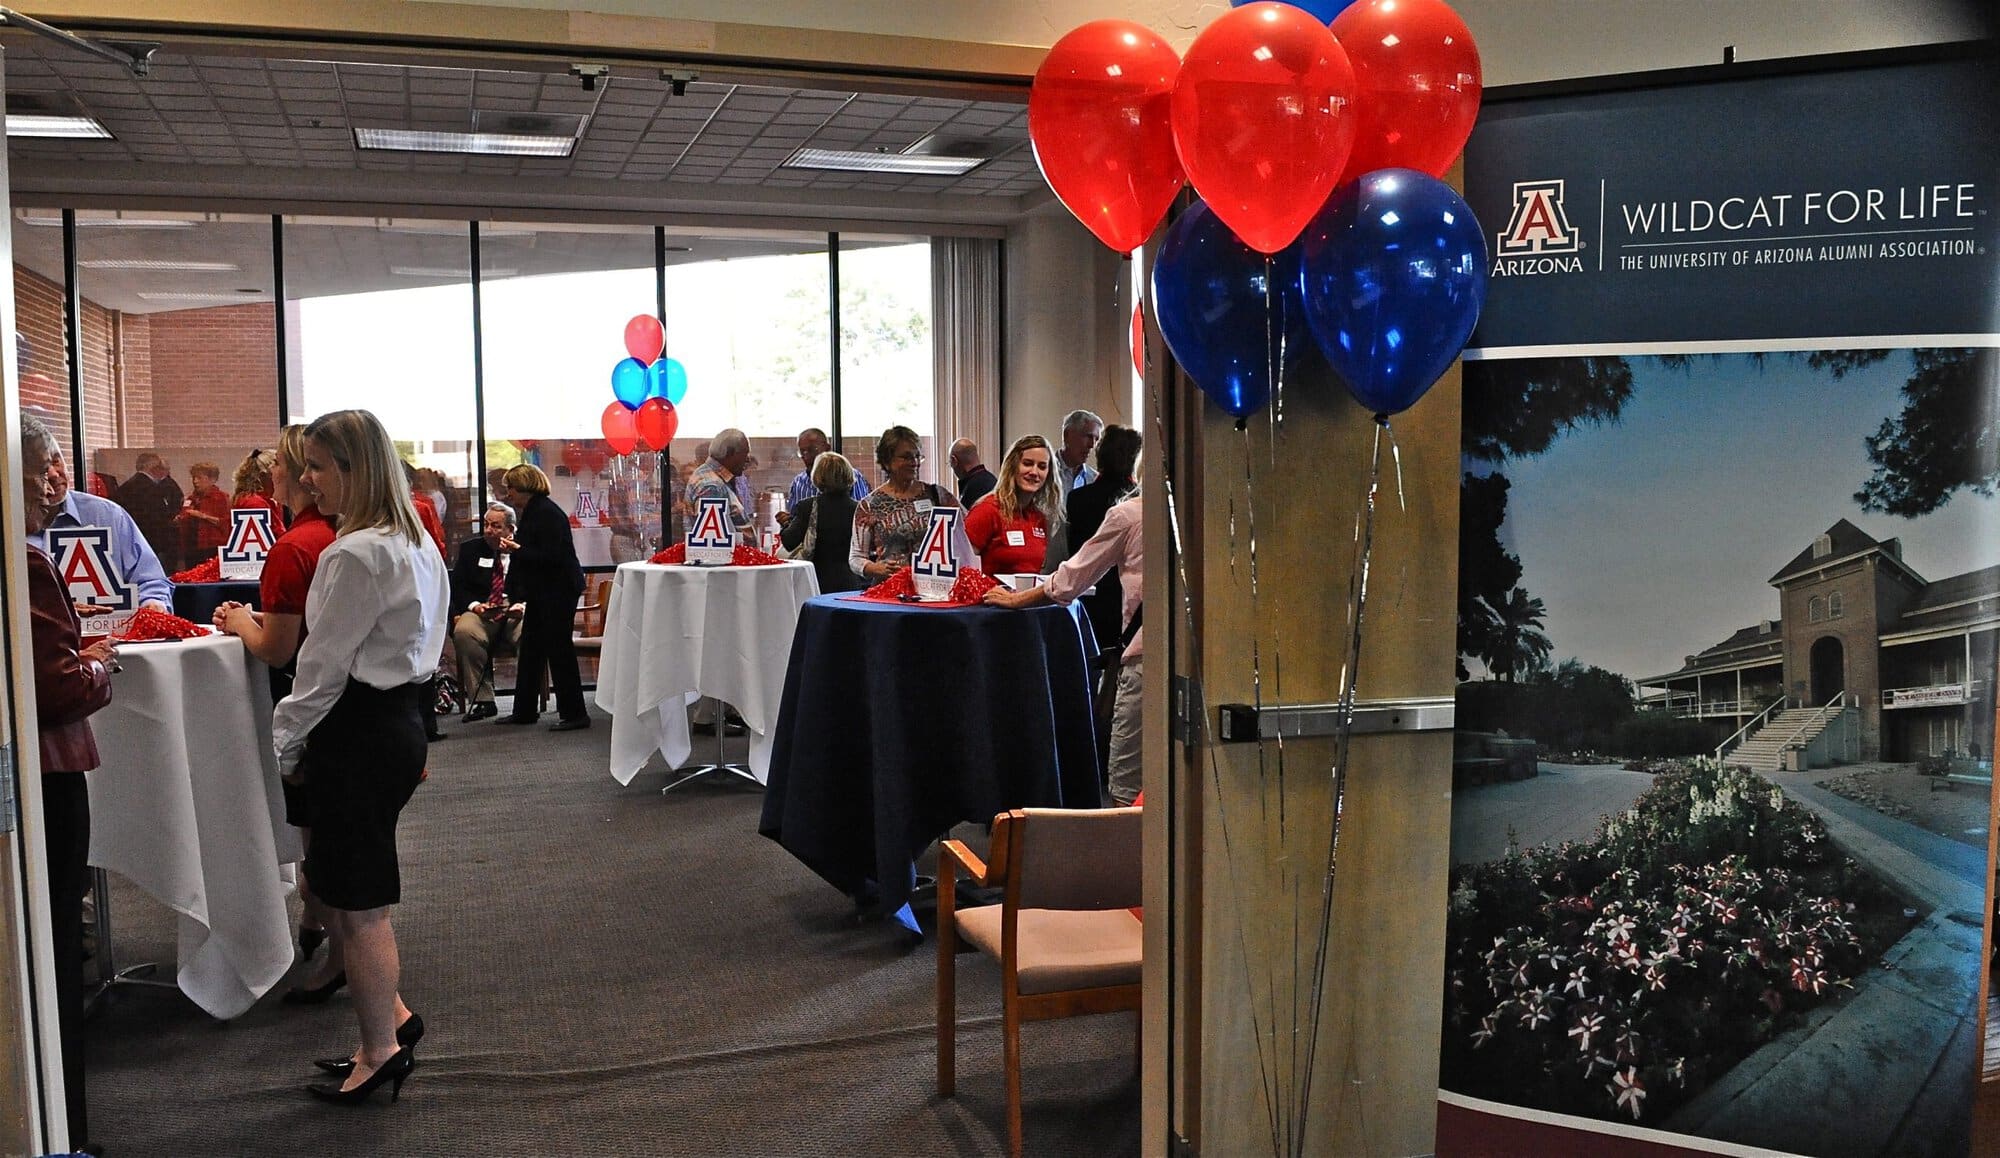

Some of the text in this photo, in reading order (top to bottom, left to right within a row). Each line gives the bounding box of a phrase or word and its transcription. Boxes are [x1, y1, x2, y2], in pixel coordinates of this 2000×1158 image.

[1497, 179, 1579, 257] A
[1622, 194, 1793, 235] WILDCAT
[1804, 189, 1886, 225] FOR
[1899, 183, 1975, 219] LIFE
[1491, 257, 1584, 278] ARIZONA
[1620, 239, 1975, 270] THE UNIVERSITY OF ARIZONA ALUMNI ASSOCIATION
[222, 509, 273, 562] A
[688, 499, 733, 548] A
[914, 508, 958, 578] A
[50, 529, 132, 611] A
[86, 620, 109, 630] FOR
